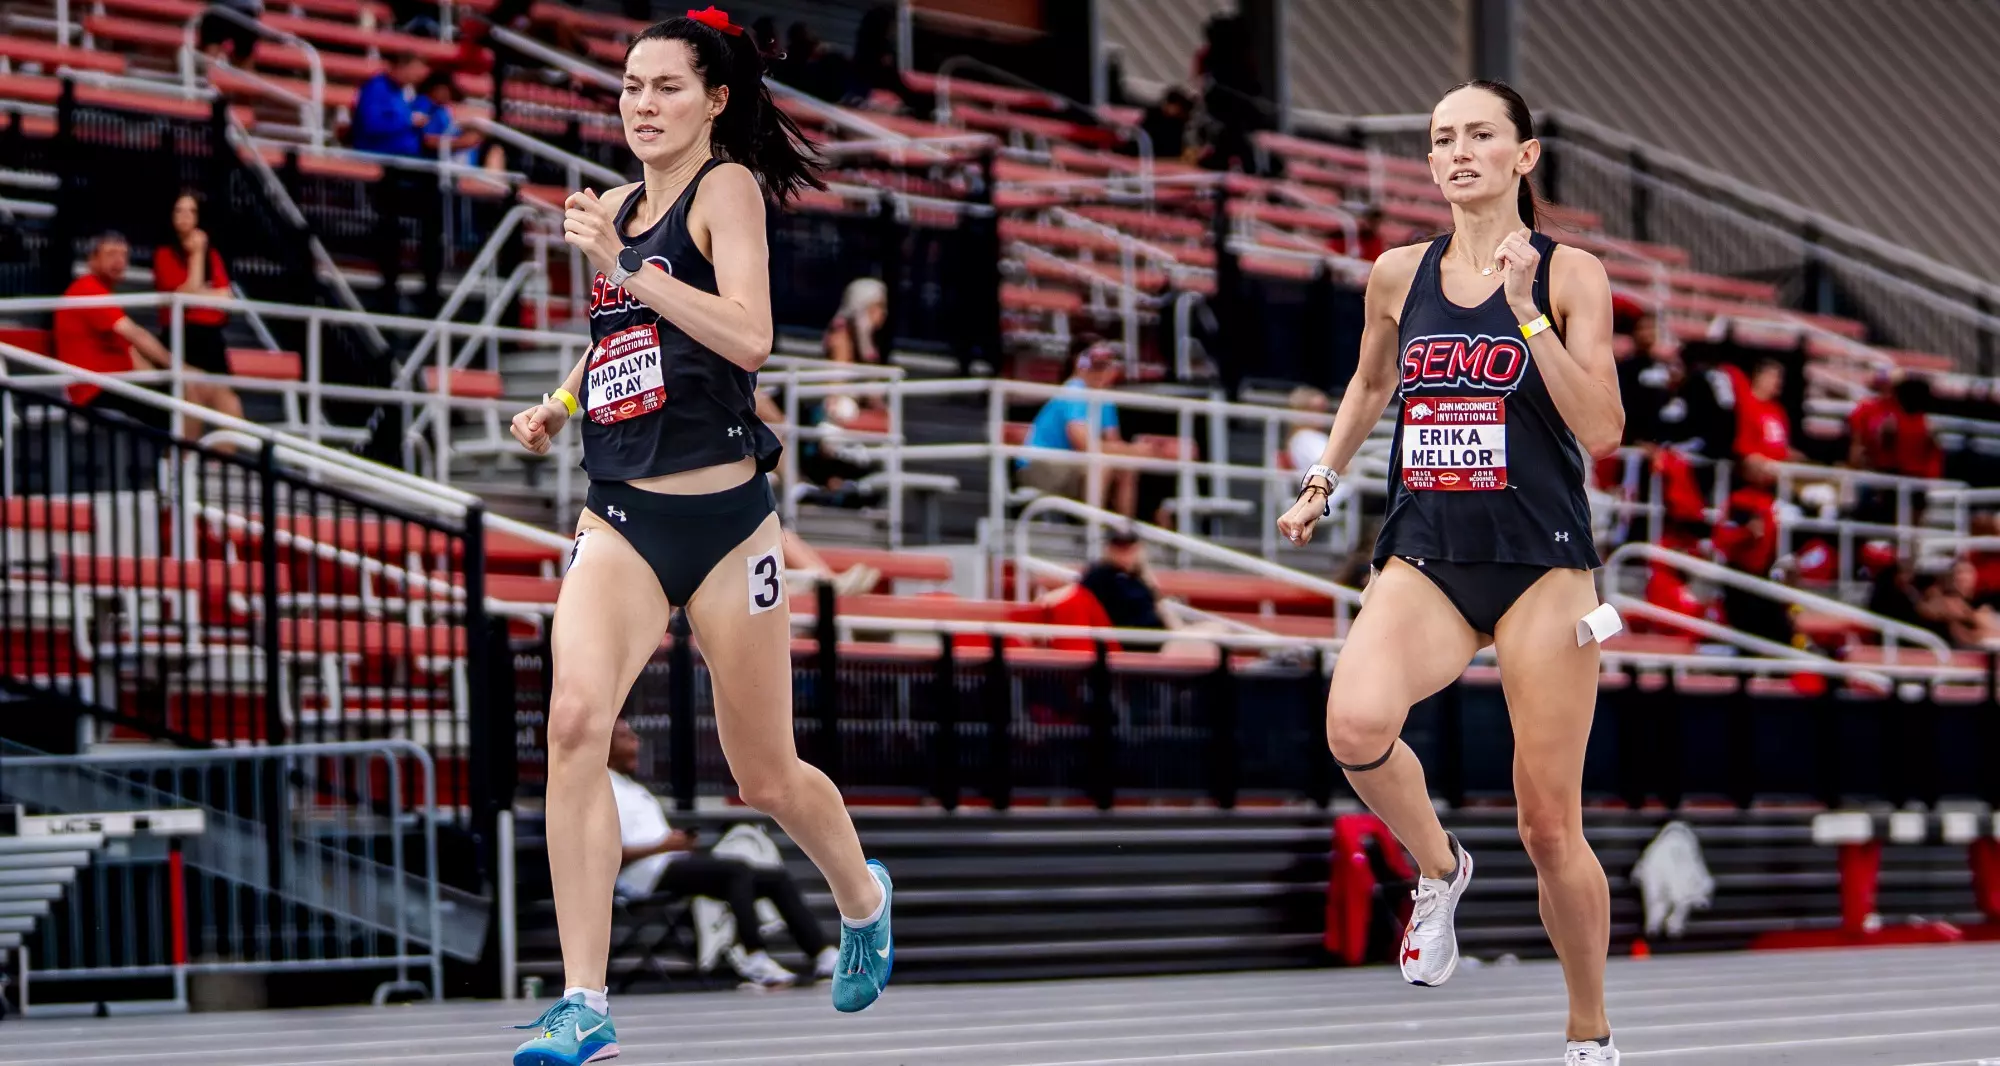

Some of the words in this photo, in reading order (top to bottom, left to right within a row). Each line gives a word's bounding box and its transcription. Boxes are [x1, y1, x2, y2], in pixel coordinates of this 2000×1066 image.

[609, 337, 654, 357] INVITATIONAL
[591, 351, 657, 389] MADALYN
[1403, 339, 1523, 385] SEMO
[605, 375, 642, 401] GRAY
[1437, 402, 1454, 411] JOHN
[1454, 402, 1498, 411] MCDONNELL
[1437, 412, 1498, 421] INVITATIONAL
[1420, 428, 1482, 445] ERIKA
[1412, 449, 1493, 466] MELLOR
[754, 555, 779, 608] 3
